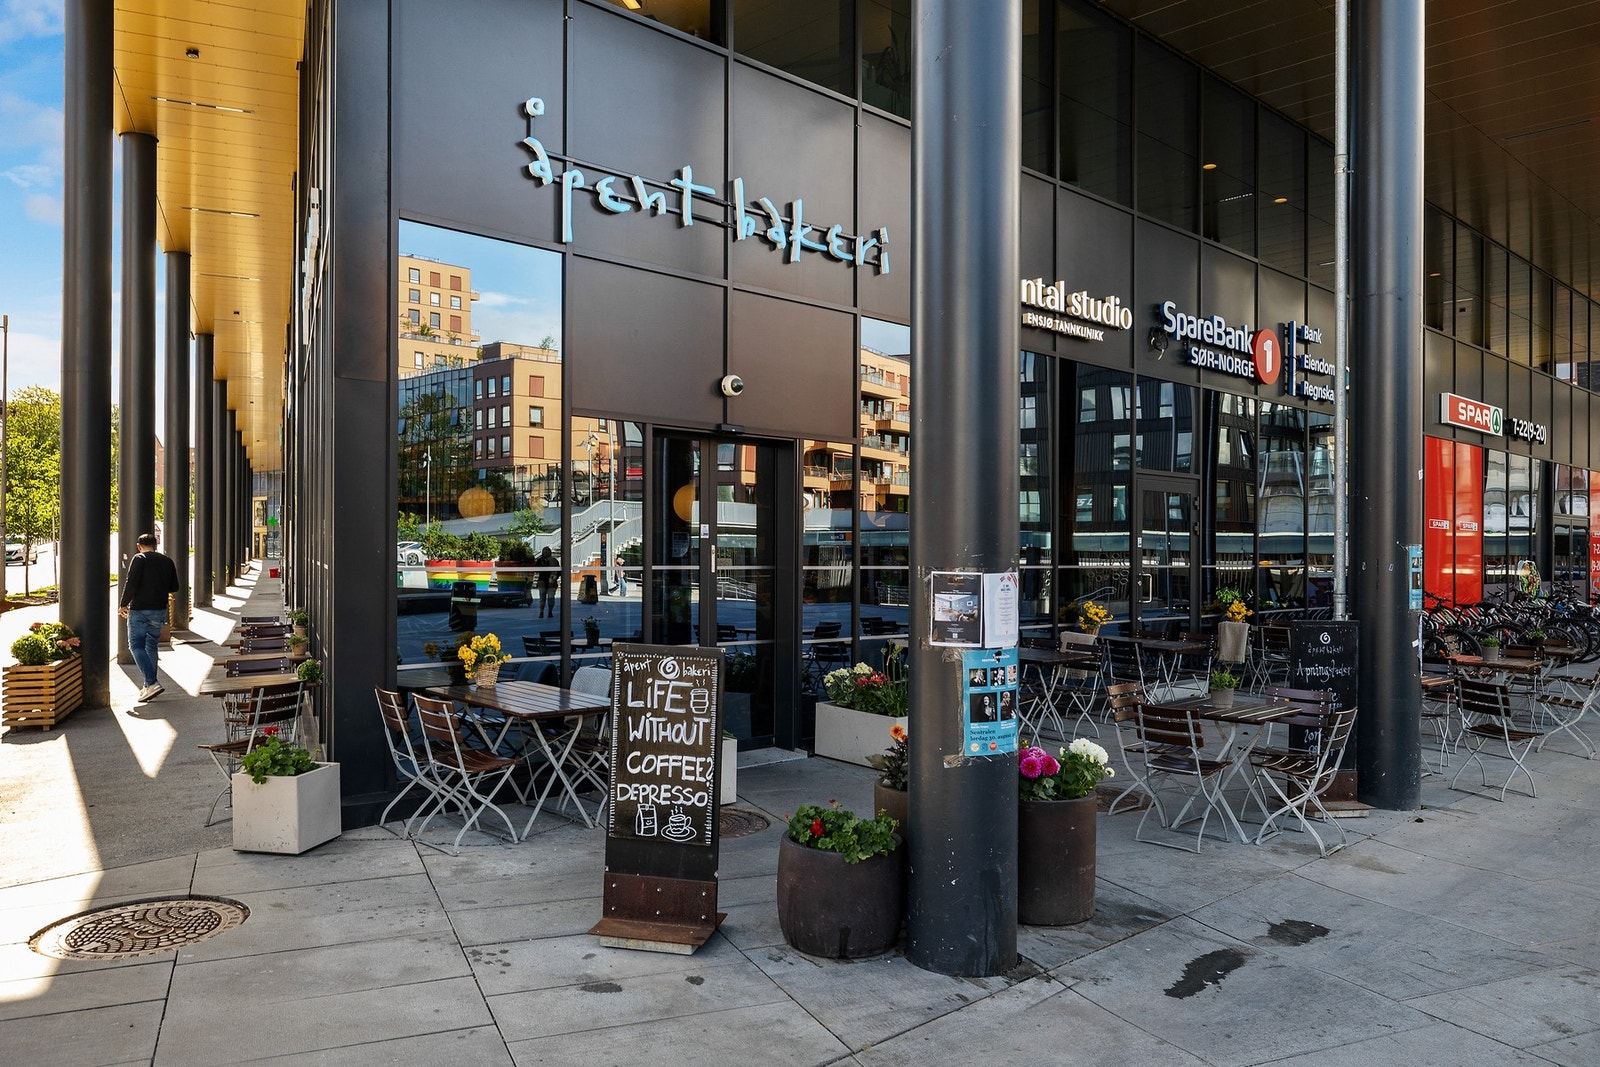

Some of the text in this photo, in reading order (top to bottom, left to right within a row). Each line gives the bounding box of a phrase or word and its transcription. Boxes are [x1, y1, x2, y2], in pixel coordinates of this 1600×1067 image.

[523, 97, 890, 275] åpent bakeri
[1021, 277, 1133, 330] ntal studio
[1026, 312, 1105, 342] ENSJØ TANNKLINIKK
[1162, 300, 1254, 355] SpareBank
[1303, 324, 1322, 344] Bank
[1190, 346, 1254, 378] SØR-NORGE
[1303, 353, 1336, 376] Eiendom
[1303, 381, 1336, 405] Regnska
[1458, 401, 1490, 427] SPAR
[623, 658, 711, 677] åpent bakeri
[617, 783, 708, 808] DEPRESSO
